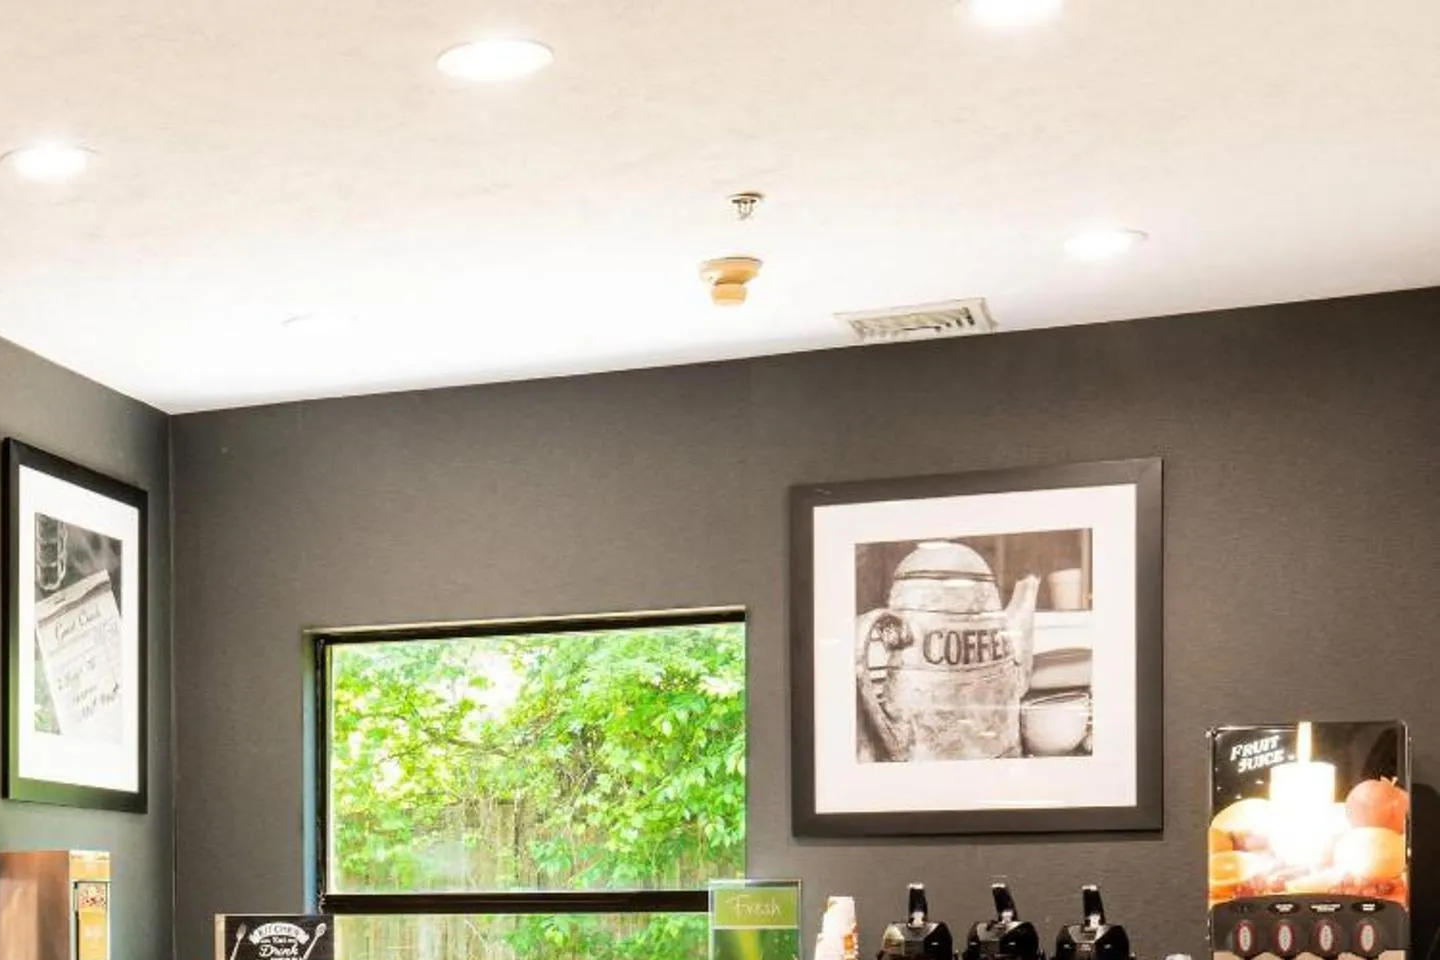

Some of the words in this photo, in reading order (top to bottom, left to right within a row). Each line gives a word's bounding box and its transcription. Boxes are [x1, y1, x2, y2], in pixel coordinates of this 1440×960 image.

[1229, 734, 1280, 762] FRUIT
[1237, 748, 1285, 773] JUICE
[724, 893, 784, 920] Fresh
[259, 941, 300, 958] Drink
